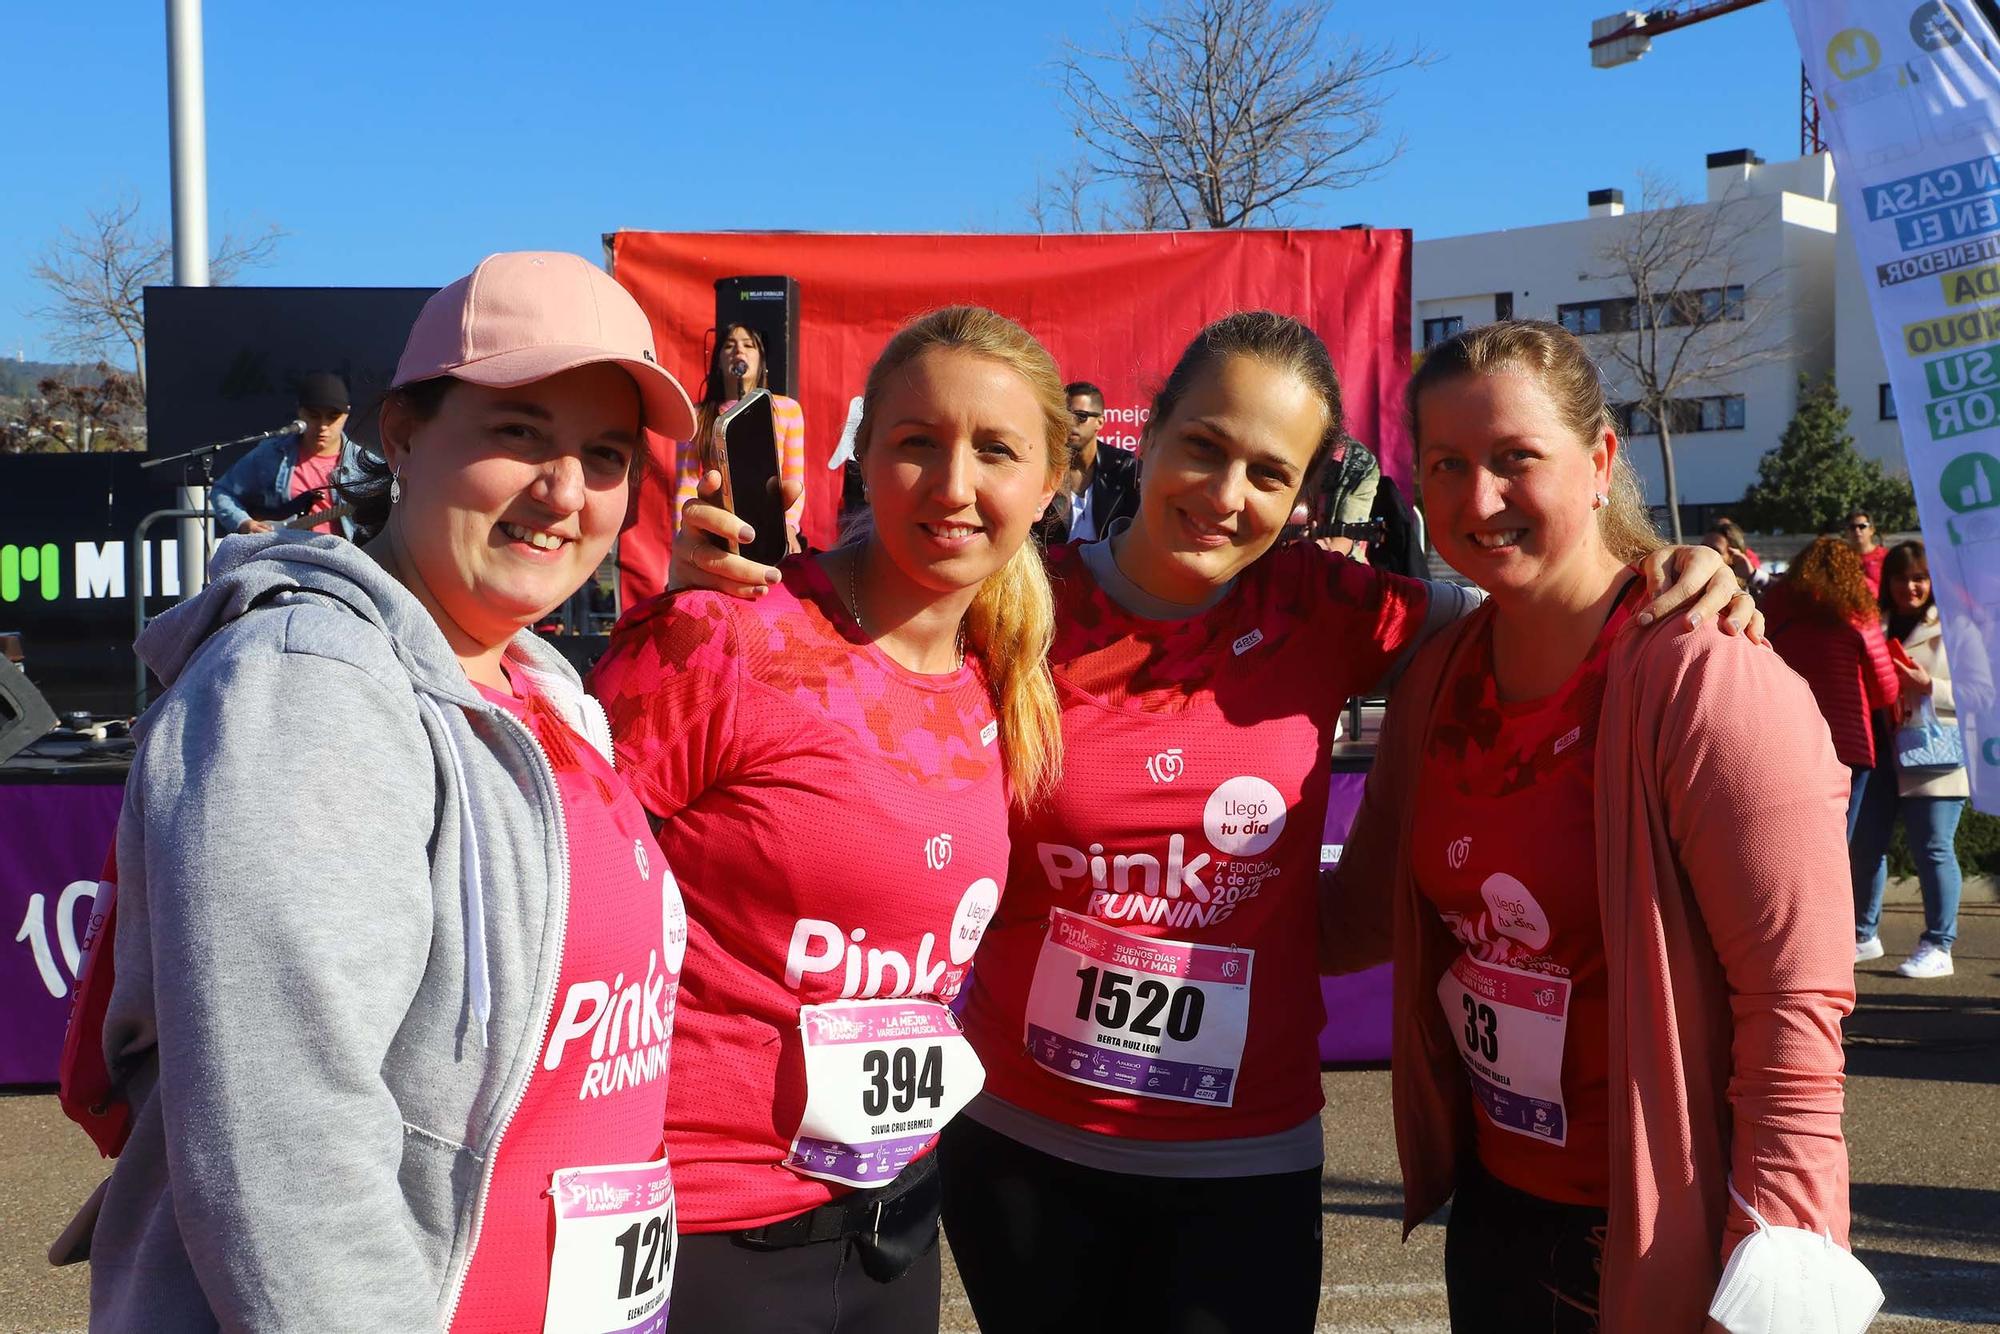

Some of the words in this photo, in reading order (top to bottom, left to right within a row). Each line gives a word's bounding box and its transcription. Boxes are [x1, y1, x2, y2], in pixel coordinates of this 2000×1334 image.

[1104, 405, 1150, 427] mejo
[1224, 800, 1268, 819] Llegó
[1221, 821, 1237, 835] tu
[1242, 819, 1269, 835] día
[1037, 833, 1211, 903] Pink
[1215, 873, 1223, 884] 6
[1227, 872, 1245, 885] de
[1248, 866, 1281, 884] marzo
[1212, 882, 1261, 905] 2022
[1088, 889, 1236, 928] RUNNING
[1492, 895, 1525, 916] Llegó
[1059, 922, 1089, 945] Pink
[784, 918, 947, 999] Pink
[1111, 953, 1140, 968] JAVI
[1140, 958, 1150, 969] Y
[1150, 960, 1178, 974] MAR
[543, 949, 664, 1071] Pink
[1076, 966, 1205, 1042] 1520
[876, 1026, 912, 1038] VARIEDAD
[911, 1025, 938, 1036] MUSICAL
[1462, 993, 1498, 1064] 33
[1096, 1033, 1122, 1047] BERTA
[1123, 1038, 1142, 1051] RUIZ
[1142, 1042, 1161, 1054] LEON
[862, 1045, 944, 1117] 394
[871, 1124, 890, 1136] SILVIA
[891, 1121, 907, 1133] CRUZ
[907, 1118, 933, 1131] BERMEJO
[568, 1182, 616, 1205] Pink
